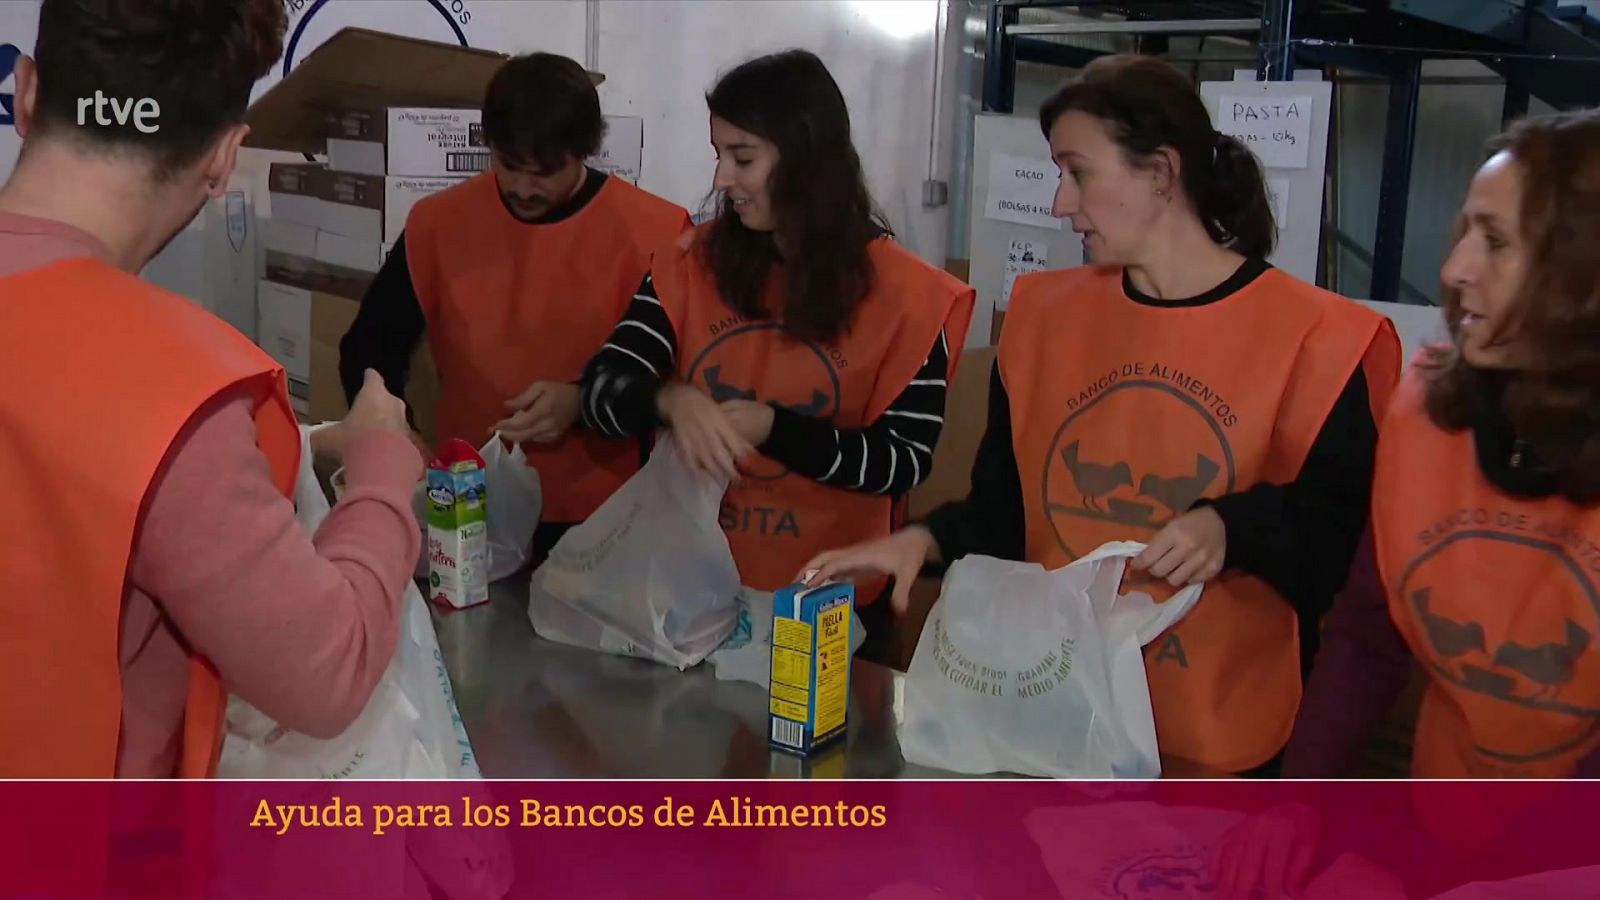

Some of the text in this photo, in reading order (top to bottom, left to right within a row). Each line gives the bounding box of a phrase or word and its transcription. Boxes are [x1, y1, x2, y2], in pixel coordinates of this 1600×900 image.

[1233, 102, 1299, 121] PASTA
[1015, 169, 1044, 180] CACAO
[1067, 362, 1237, 428] BANCO DE ALIMENTOS
[950, 668, 988, 695] CUIDAR
[992, 683, 1003, 696] EL
[1017, 678, 1054, 699] MEDIO
